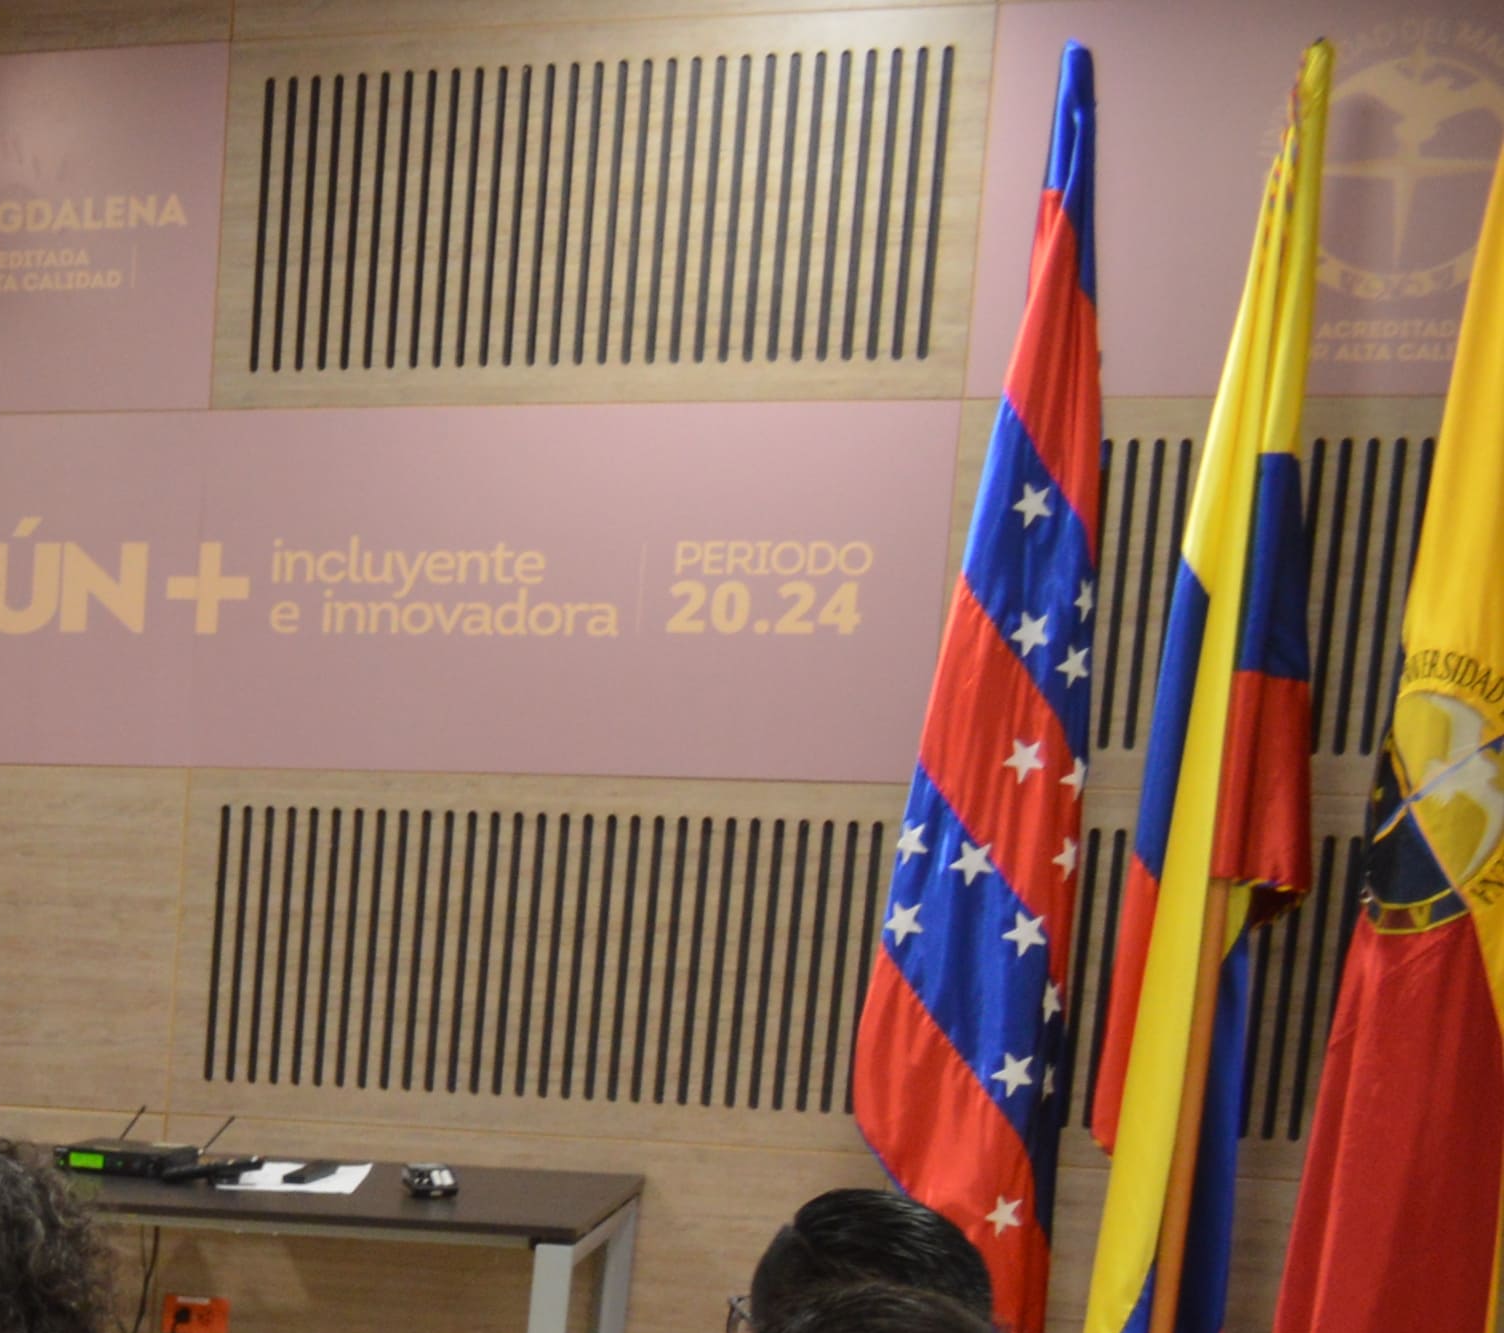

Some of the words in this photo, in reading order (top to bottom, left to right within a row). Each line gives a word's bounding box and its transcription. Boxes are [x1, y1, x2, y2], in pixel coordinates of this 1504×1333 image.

[21, 269, 122, 292] CALIDAD
[1314, 319, 1460, 338] ACREDITAD
[270, 537, 547, 598] incluyente
[673, 541, 874, 578] PERIODO
[269, 604, 299, 637] e
[320, 588, 620, 638] innovadora
[665, 582, 861, 636] 20.24
